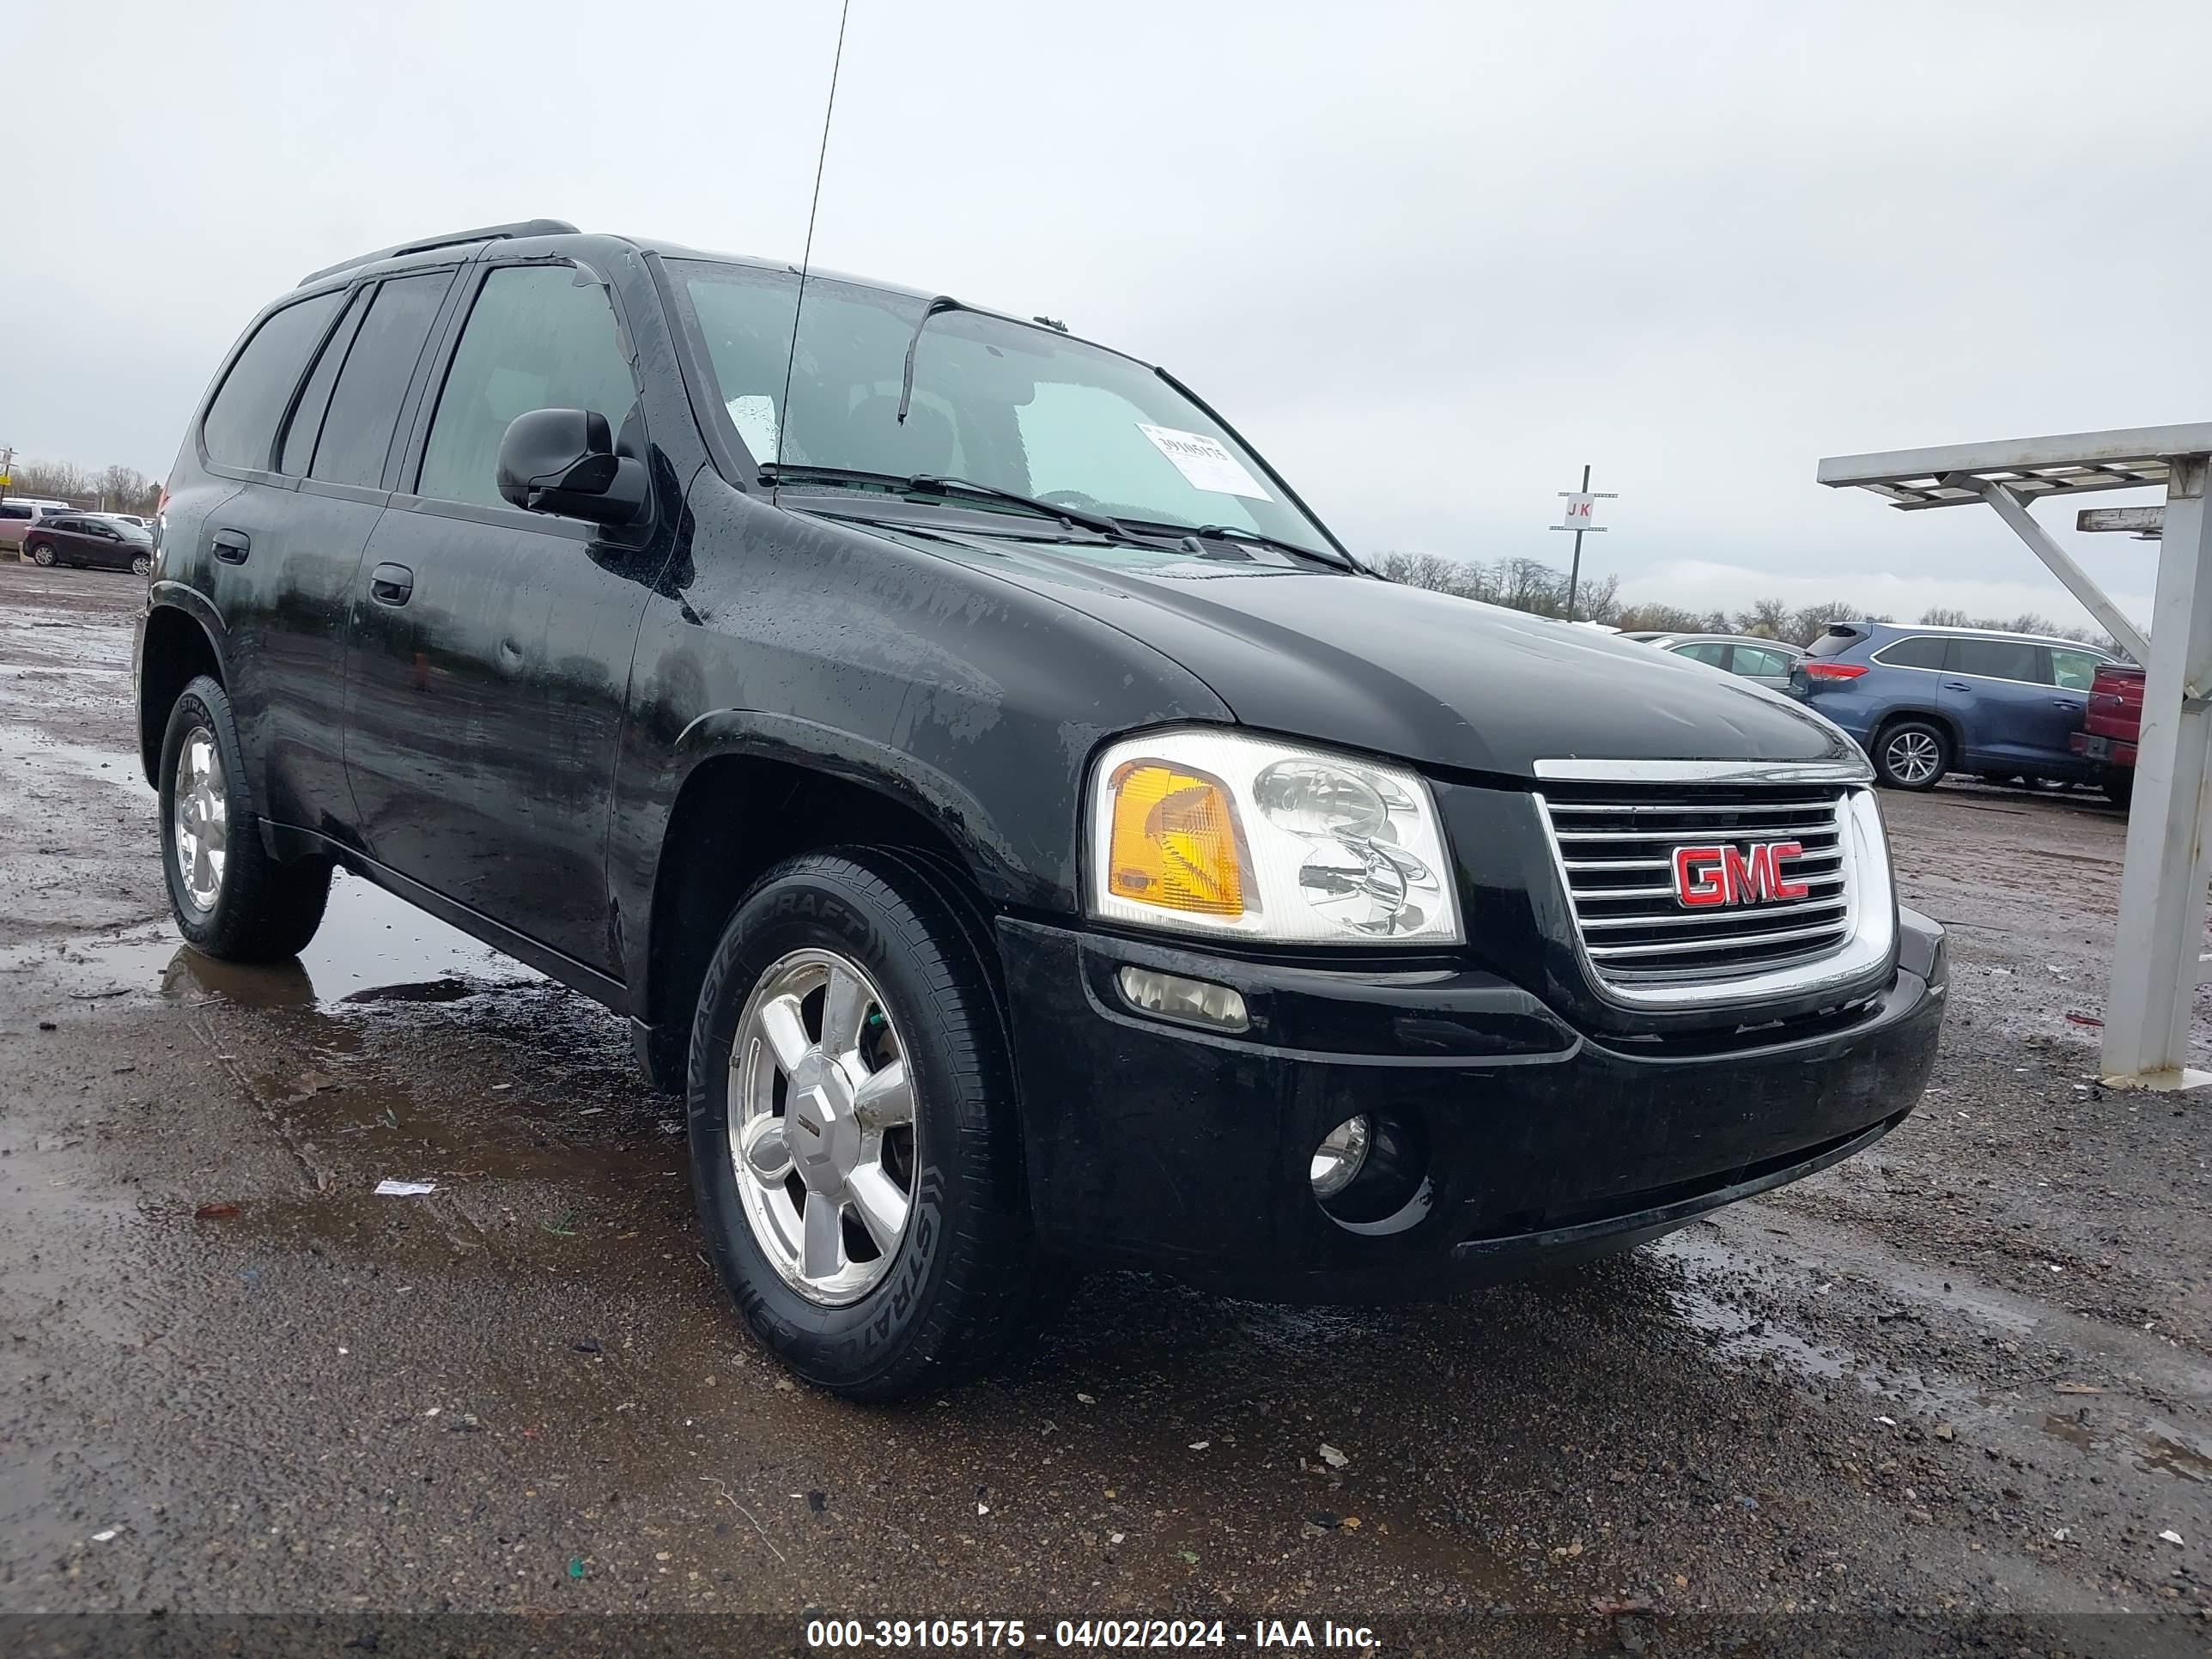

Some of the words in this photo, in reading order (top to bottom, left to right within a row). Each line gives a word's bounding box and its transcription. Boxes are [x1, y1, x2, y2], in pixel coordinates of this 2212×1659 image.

[1158, 438, 1228, 460] 39105175
[1671, 841, 1808, 908] GMC
[811, 1207, 933, 1364] STRATU
